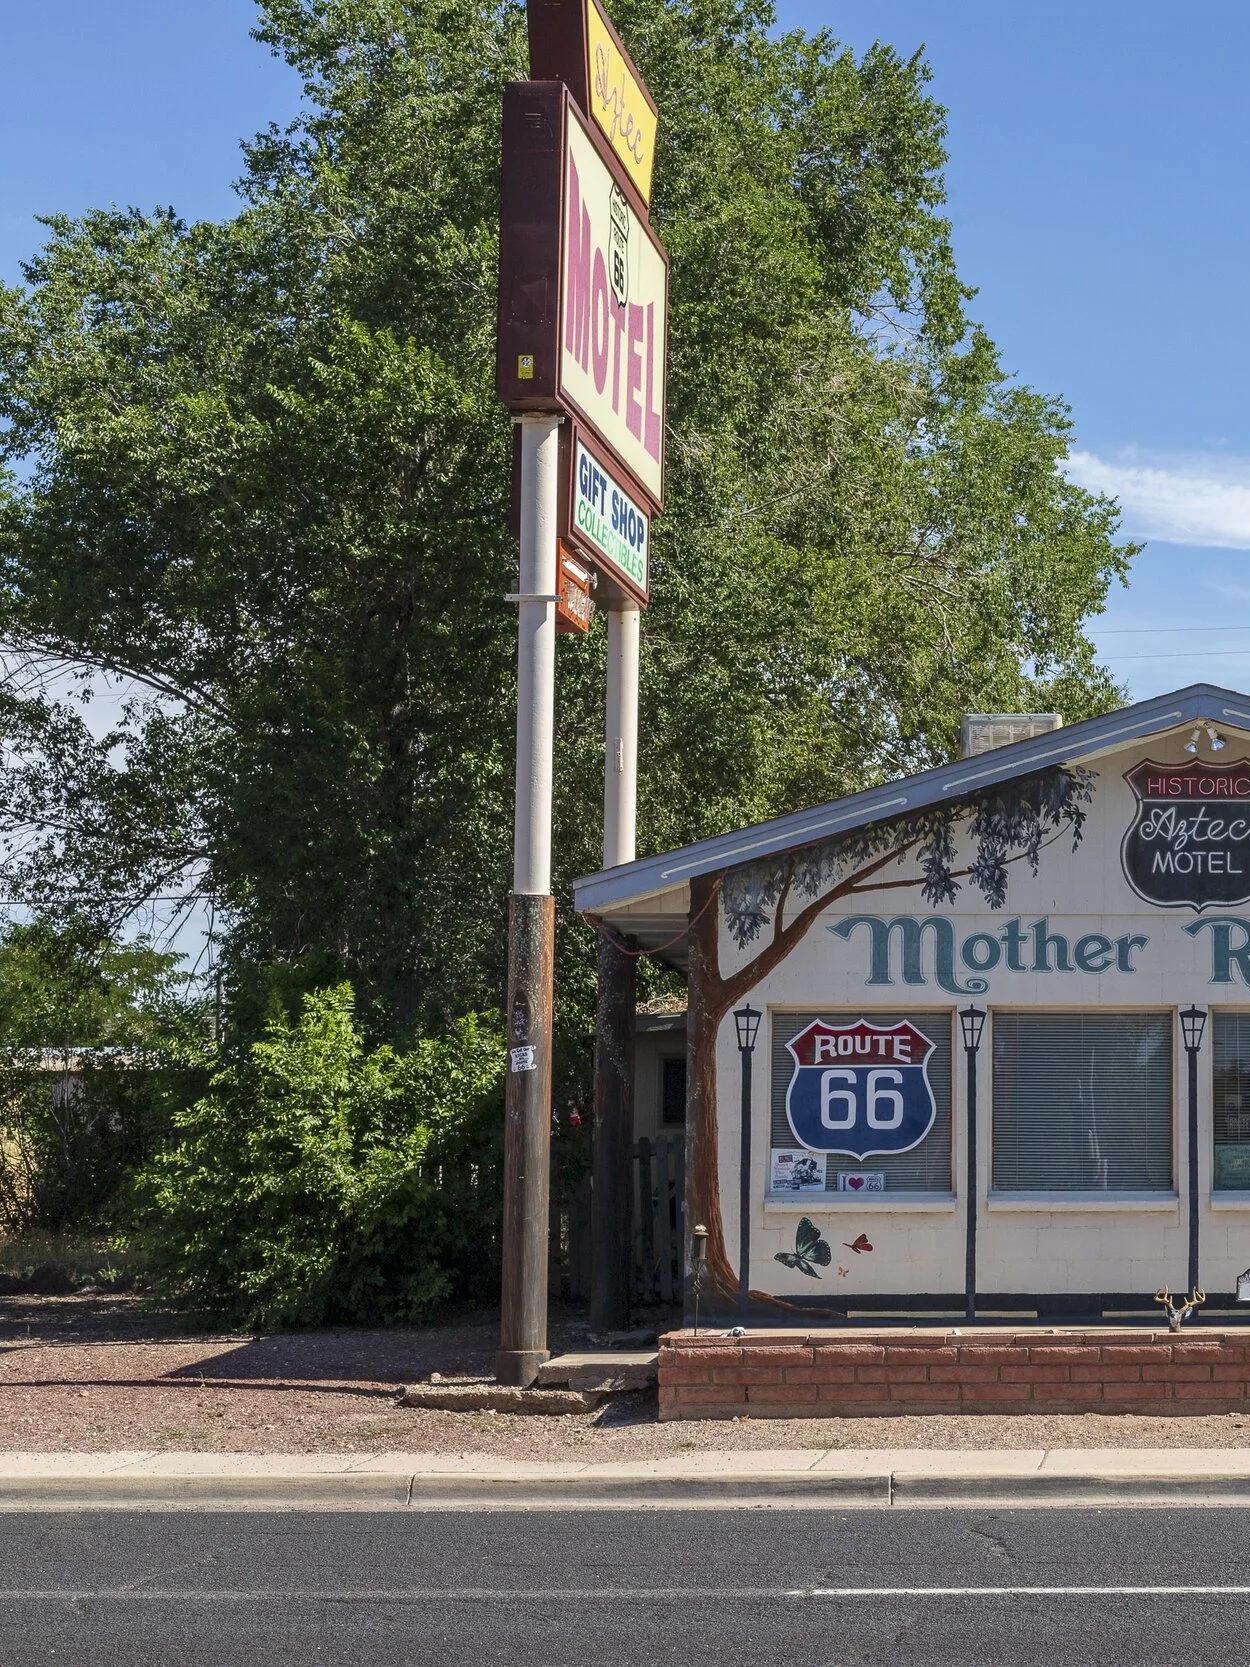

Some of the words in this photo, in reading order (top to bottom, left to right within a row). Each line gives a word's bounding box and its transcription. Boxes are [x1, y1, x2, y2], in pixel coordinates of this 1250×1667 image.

[596, 42, 643, 164] Aztec
[612, 196, 627, 230] HISTORIC
[613, 225, 625, 255] ROUTE
[613, 250, 625, 296] 66
[565, 145, 661, 465] MOTEL
[579, 453, 608, 517] GIFT
[611, 490, 645, 553] SHOP
[577, 499, 643, 583] COLLECTIBLES
[1147, 777, 1250, 795] HISTORIC
[1152, 851, 1243, 874] MOTEL
[825, 914, 1151, 997] Mother
[814, 1034, 912, 1065] ROUTE
[820, 1069, 905, 1130] 66
[868, 1182, 880, 1190] 66
